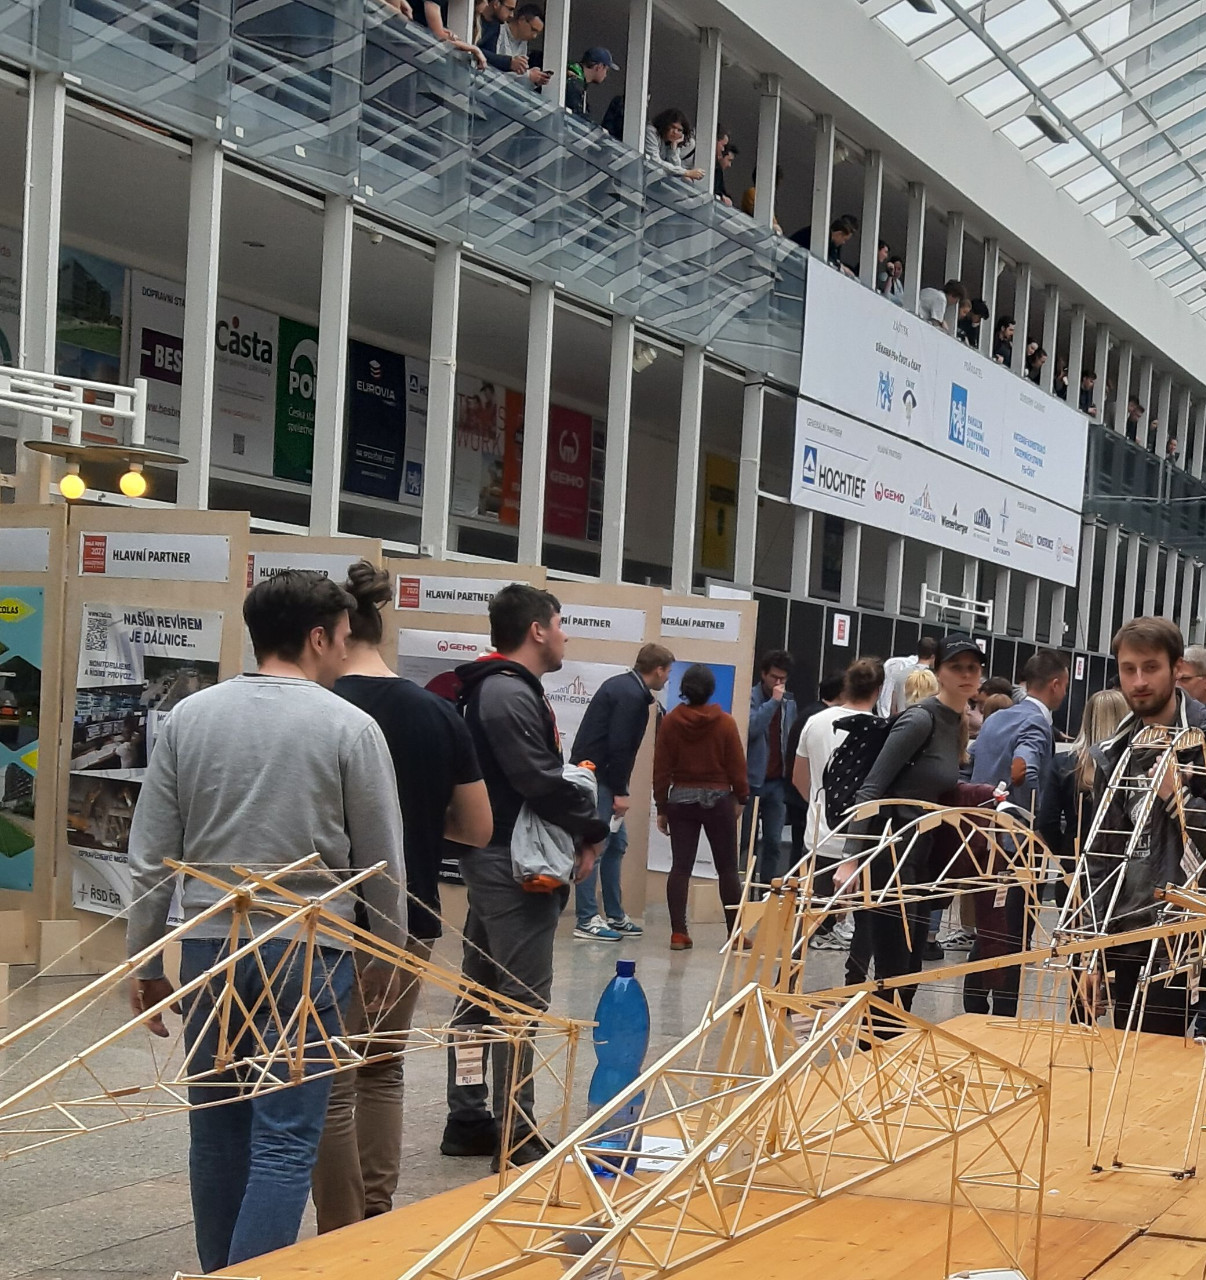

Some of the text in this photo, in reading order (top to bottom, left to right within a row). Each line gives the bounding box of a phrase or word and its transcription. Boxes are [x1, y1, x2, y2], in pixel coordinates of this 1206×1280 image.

[356, 380, 396, 400] EUROVIA
[550, 470, 585, 489] GEMO
[818, 464, 866, 500] HOCHTIEF
[883, 488, 905, 504] GEMO
[112, 548, 191, 563] HLAVNÍ PARTNER
[425, 588, 456, 600] HLAVNÍ
[123, 609, 203, 630] NAŠÍM REVÍREM
[572, 616, 611, 628] PARTNER
[661, 615, 725, 630] NERÁLNÍ PARTNER
[129, 630, 141, 643] JE
[449, 643, 477, 652] GEMO
[545, 693, 592, 705] SAINT-GOBA
[90, 884, 121, 905] ŘSD ČR
